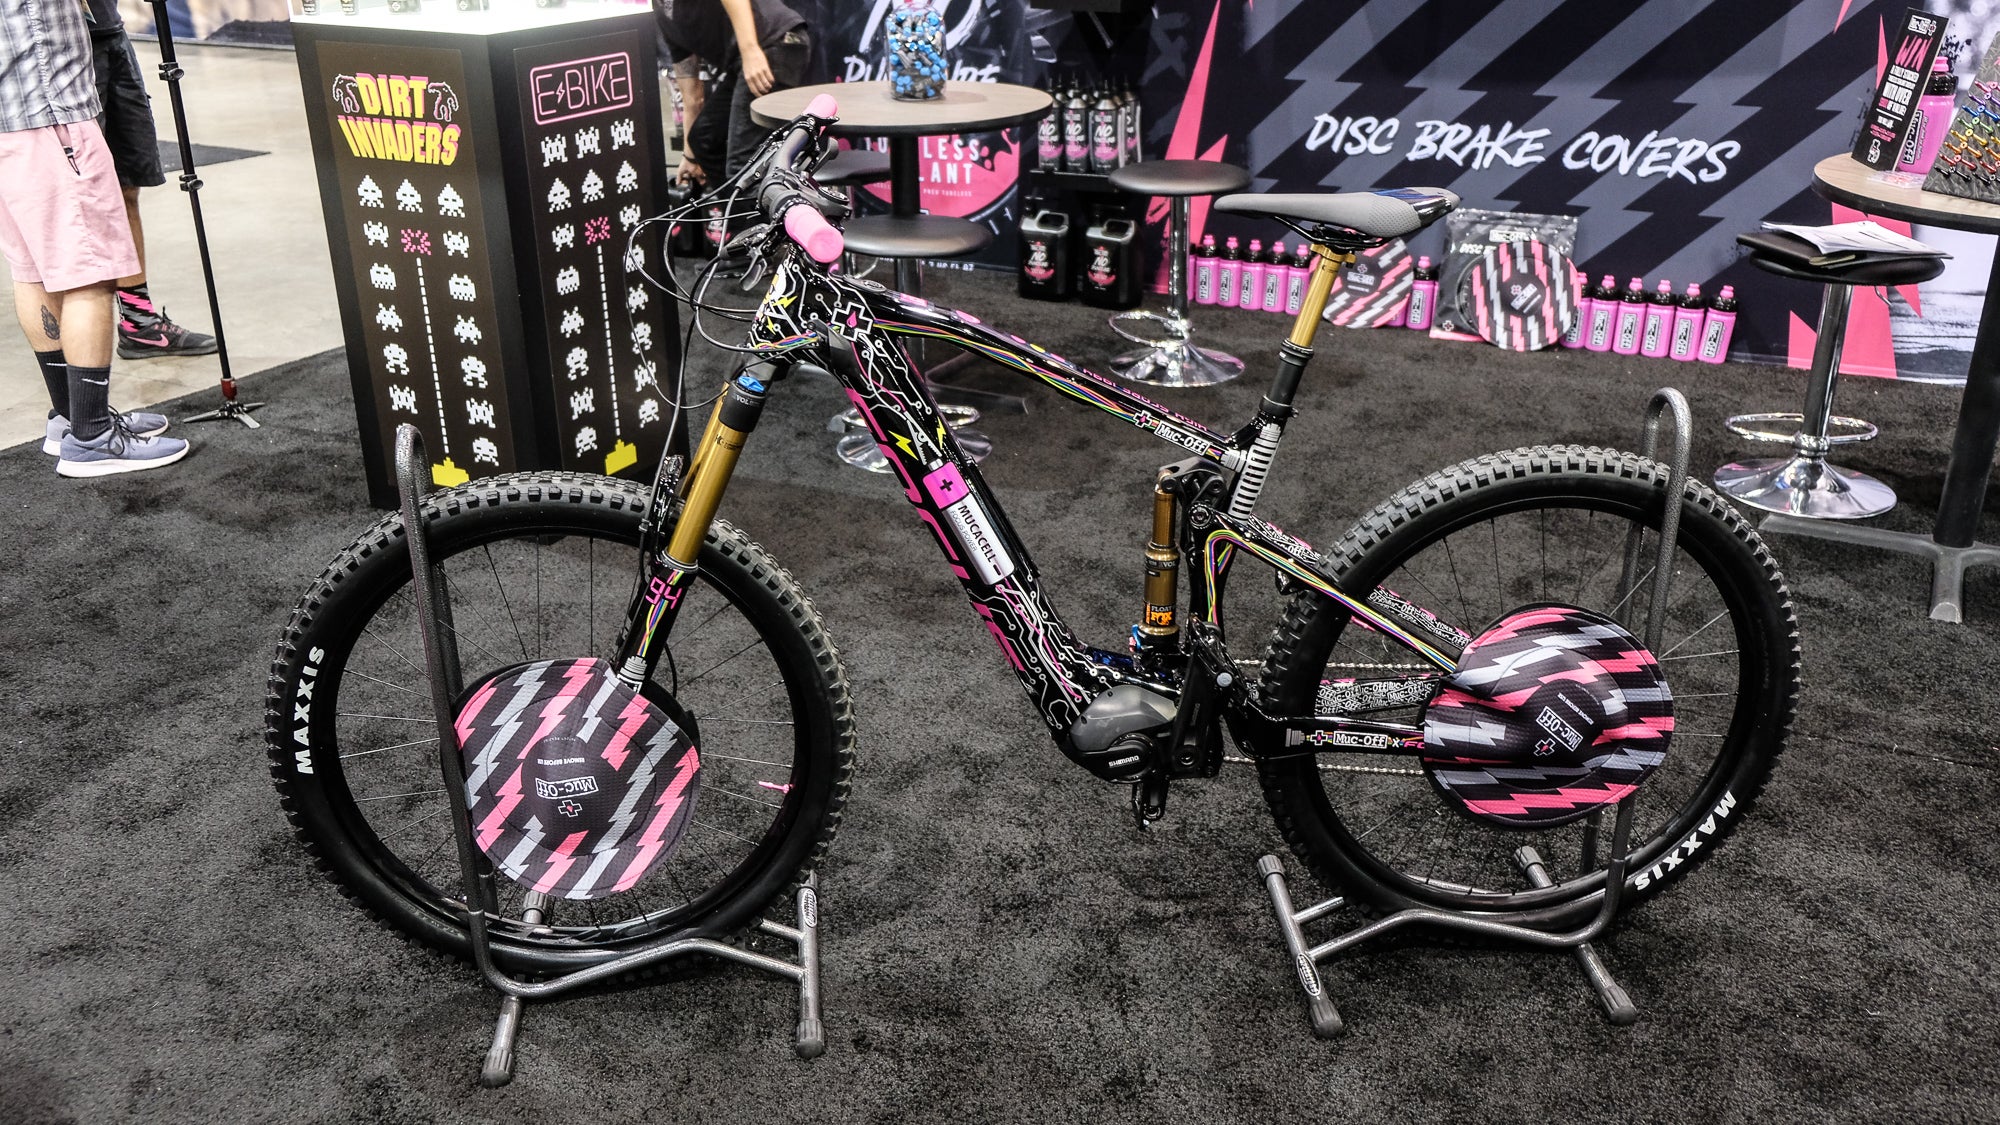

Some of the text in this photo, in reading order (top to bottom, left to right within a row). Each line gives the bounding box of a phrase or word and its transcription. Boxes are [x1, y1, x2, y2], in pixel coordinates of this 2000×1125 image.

[1895, 35, 1933, 71] WIN
[356, 73, 428, 119] DIRT
[338, 115, 461, 165] INVADERS
[1040, 124, 1055, 135] NO
[1067, 123, 1081, 135] NO
[1095, 124, 1113, 137] NO
[1305, 113, 1741, 185] DISC BRAKE COVERS
[1157, 424, 1208, 454] Muc-Off
[950, 510, 977, 552] FOCUS POWER
[958, 505, 996, 563] MUCACELL
[645, 577, 683, 610] 94
[1151, 611, 1172, 625] FOX
[293, 646, 325, 775] MAXXIS
[1335, 733, 1386, 747] Muc-Off
[1539, 710, 1580, 748] Muc-Off
[1108, 755, 1140, 767] SHIMANO
[538, 779, 595, 797] Muc-Off
[1634, 790, 1737, 891] MAXXIS
